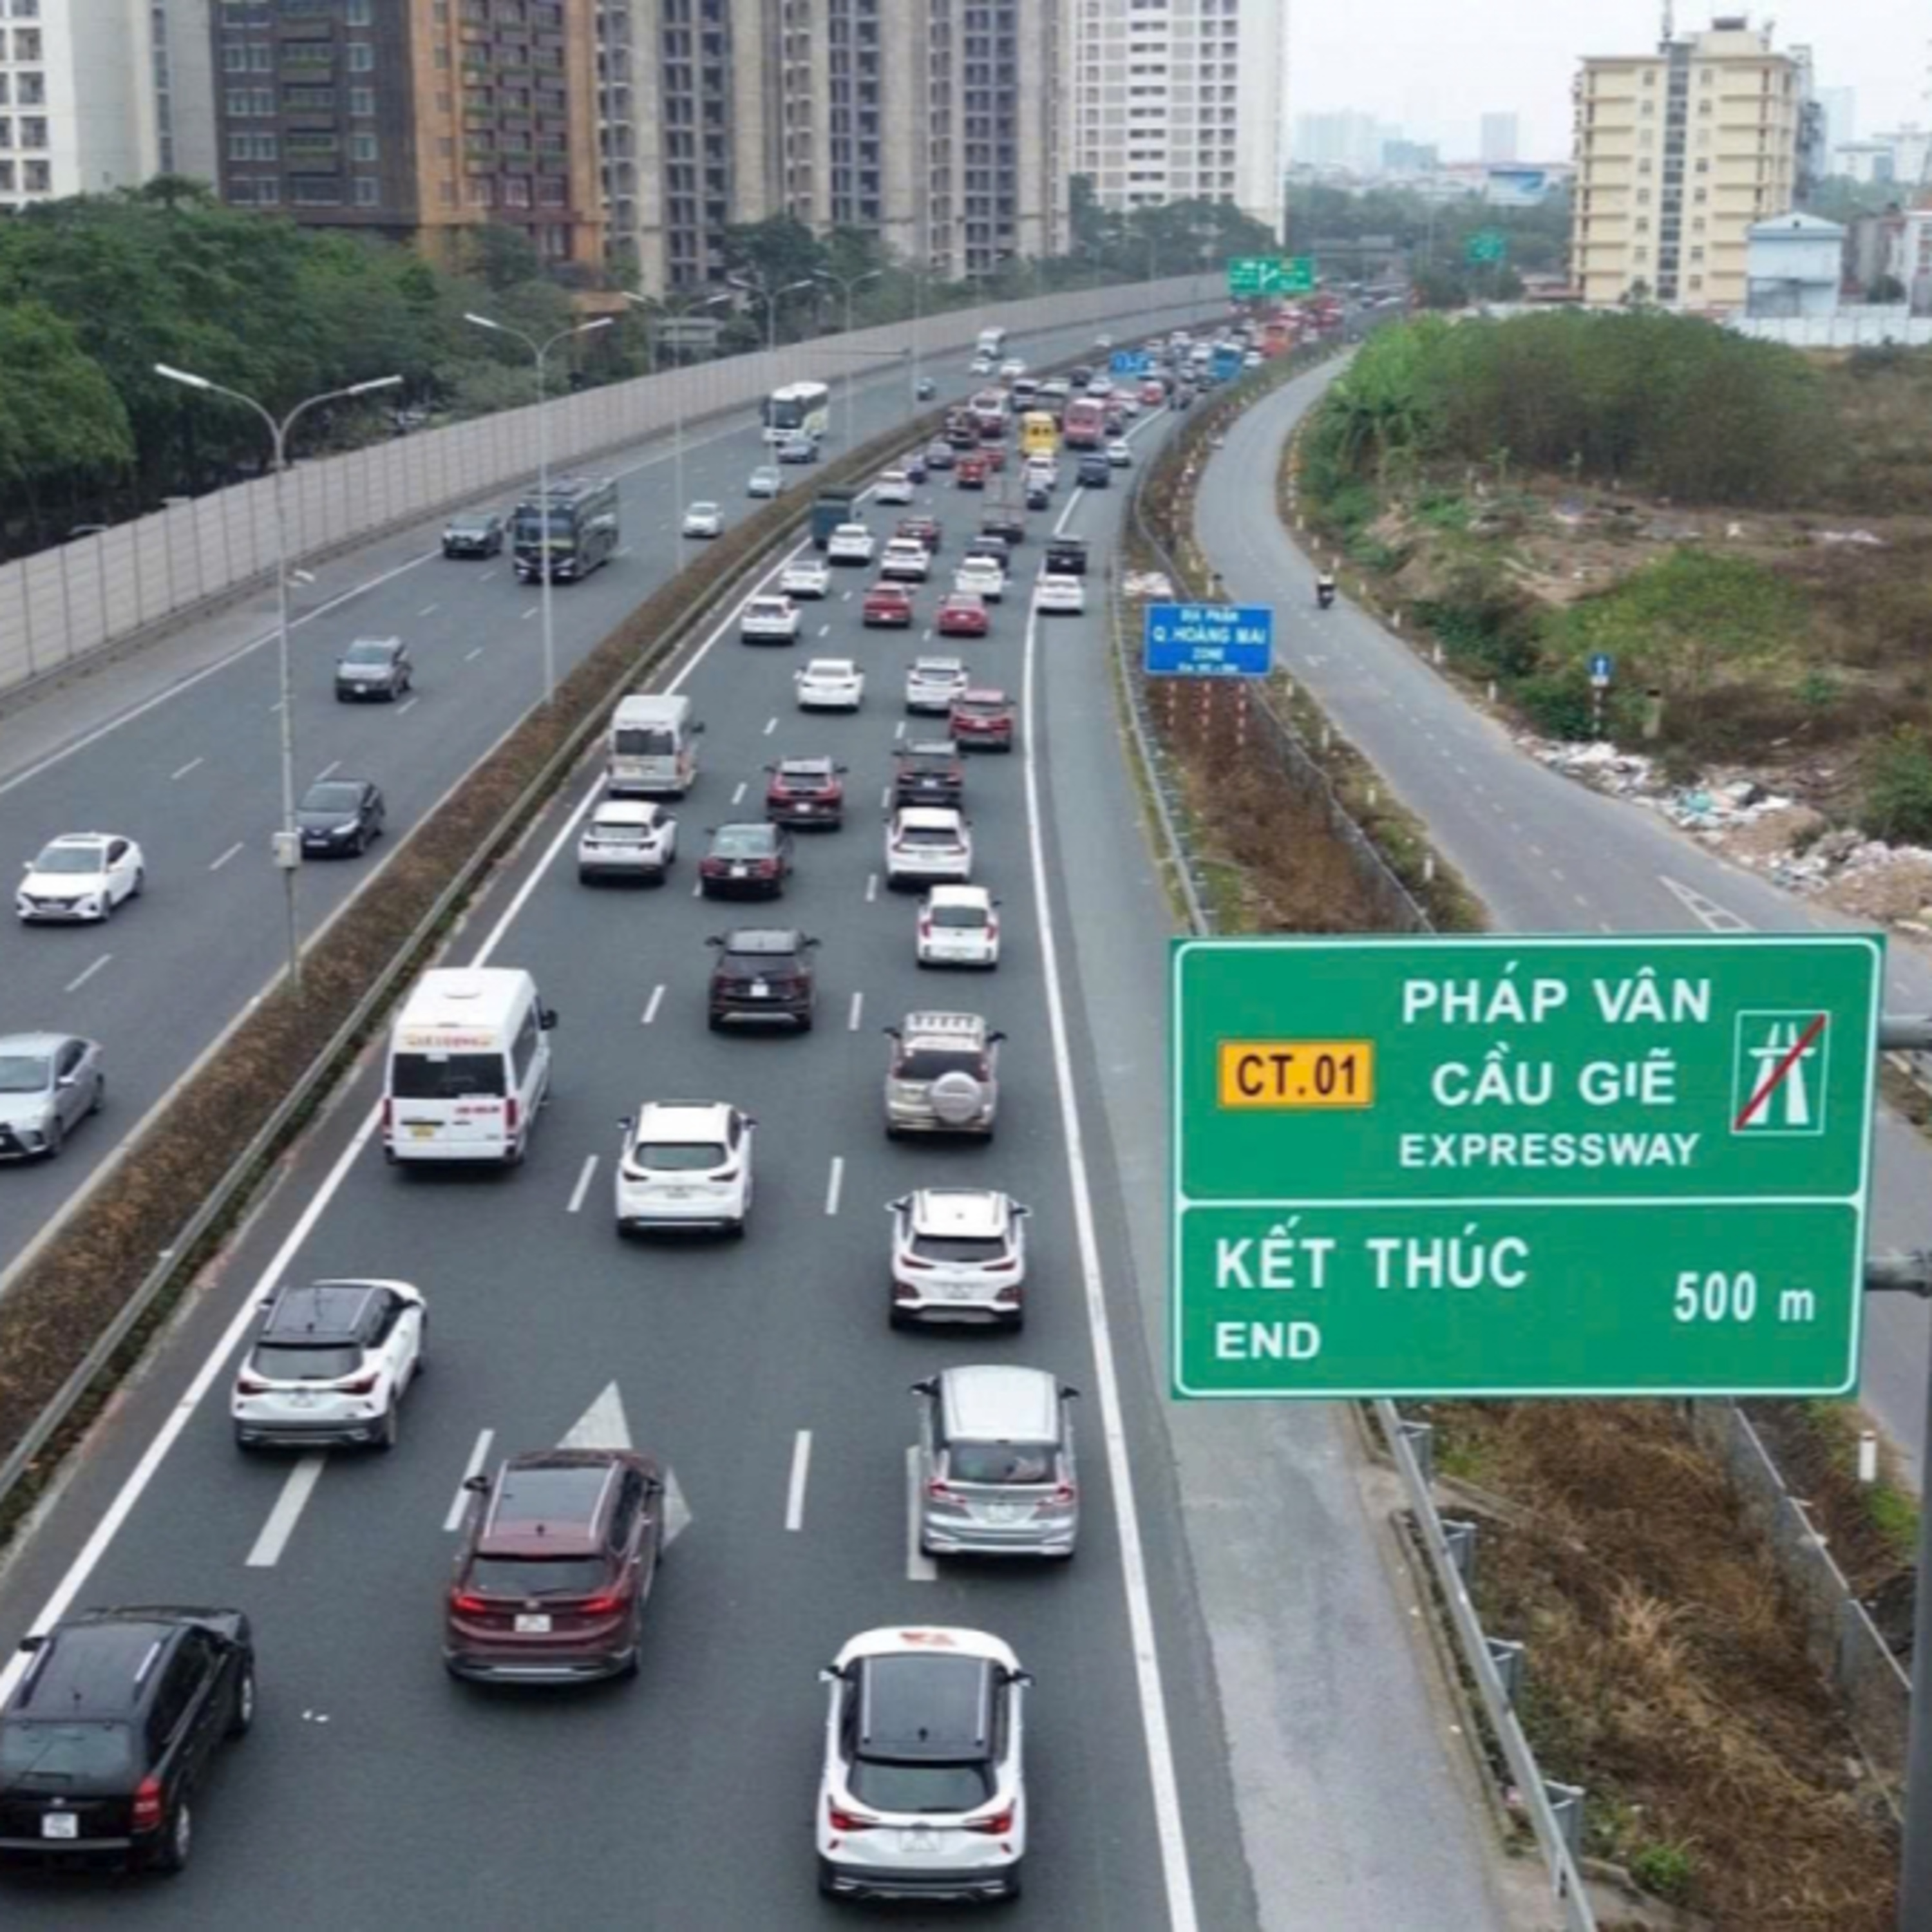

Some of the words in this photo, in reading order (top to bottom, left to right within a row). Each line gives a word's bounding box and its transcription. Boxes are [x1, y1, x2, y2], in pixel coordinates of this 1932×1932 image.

[1404, 962, 1566, 1022] PHÁP
[1594, 967, 1709, 1022] VÂN
[1236, 1054, 1357, 1097] CT.01
[1432, 1043, 1551, 1105] CẦU
[1579, 1048, 1674, 1105] GIẼ
[1401, 1133, 1698, 1166] EXPRESSWAY
[1217, 1217, 1334, 1288] KẾT
[1367, 1224, 1528, 1288] THÚC
[1675, 1272, 1756, 1321] 500
[1780, 1291, 1814, 1320] m
[1217, 1322, 1320, 1359] END
